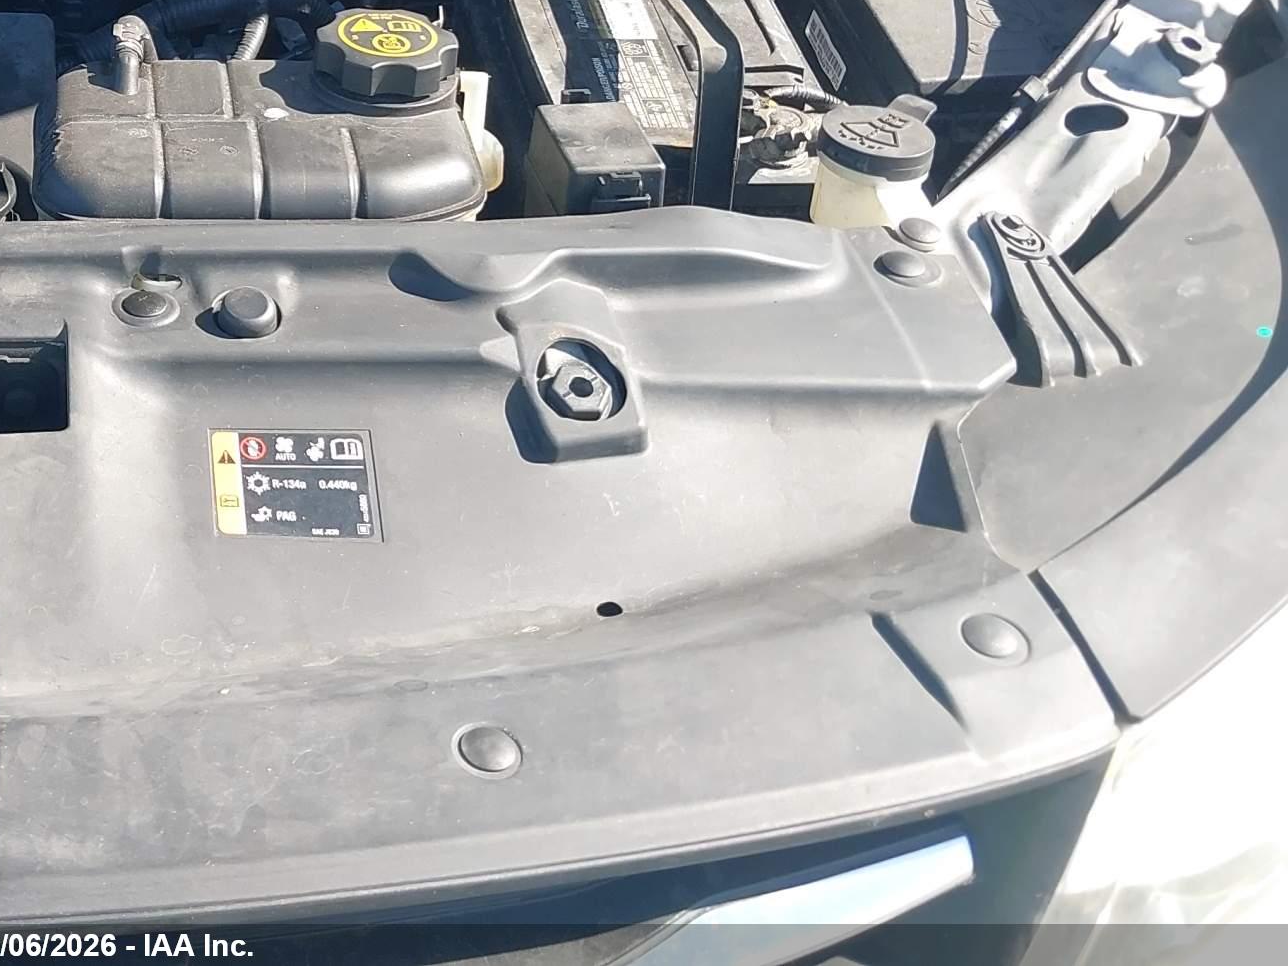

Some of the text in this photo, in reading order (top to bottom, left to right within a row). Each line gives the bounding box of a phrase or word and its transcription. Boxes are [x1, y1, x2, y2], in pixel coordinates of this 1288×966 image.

[275, 452, 296, 461] AUTO
[271, 479, 307, 490] R-134a
[276, 511, 297, 522] PAG
